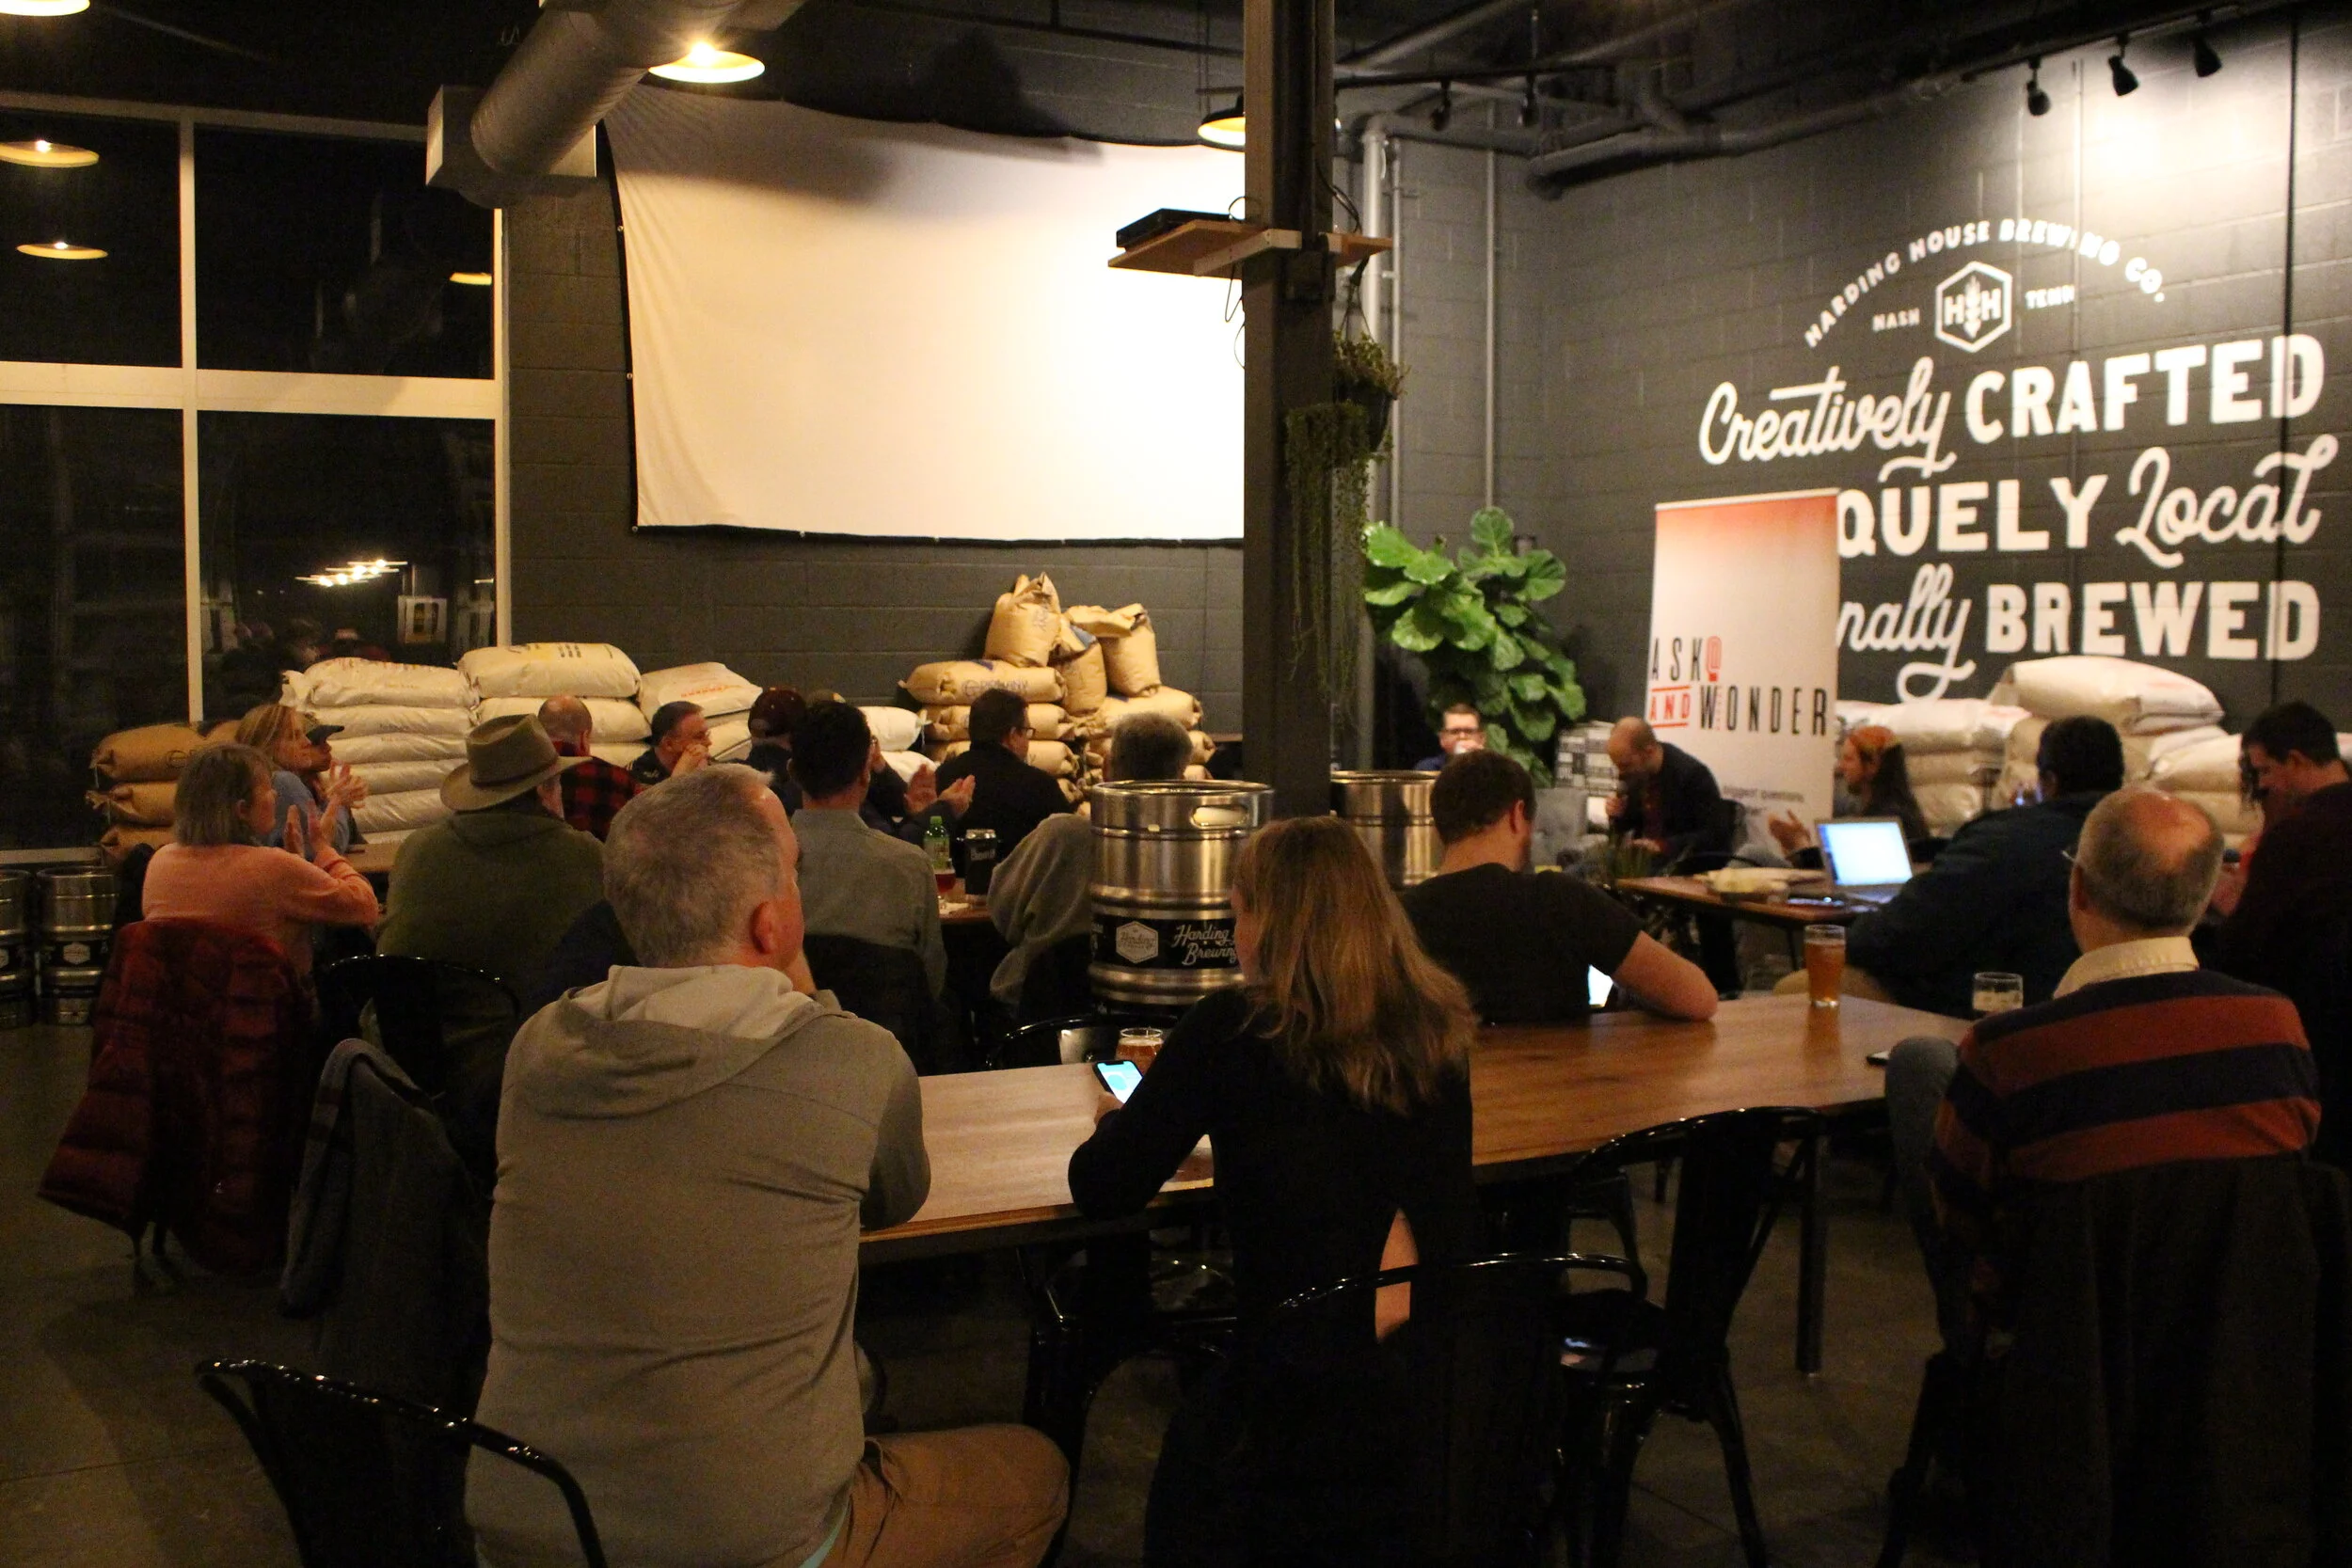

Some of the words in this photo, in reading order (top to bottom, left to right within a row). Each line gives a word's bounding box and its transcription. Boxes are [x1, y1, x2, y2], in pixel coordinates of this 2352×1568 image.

[1804, 252, 1900, 348] HARDING
[1909, 221, 1991, 262] HOUSE
[1999, 218, 2121, 266] BREWING
[1872, 307, 1920, 332] NASH
[1698, 356, 1958, 483] Creatively
[1964, 334, 2325, 444] CRAFTED
[1837, 474, 2109, 558] QUELY
[2115, 434, 2339, 568] Local
[1836, 562, 1977, 705] nally
[1986, 580, 2321, 660] BREWED
[1649, 693, 1692, 721] AND
[1700, 684, 1828, 736] WONDER
[1170, 924, 1232, 951] Harding
